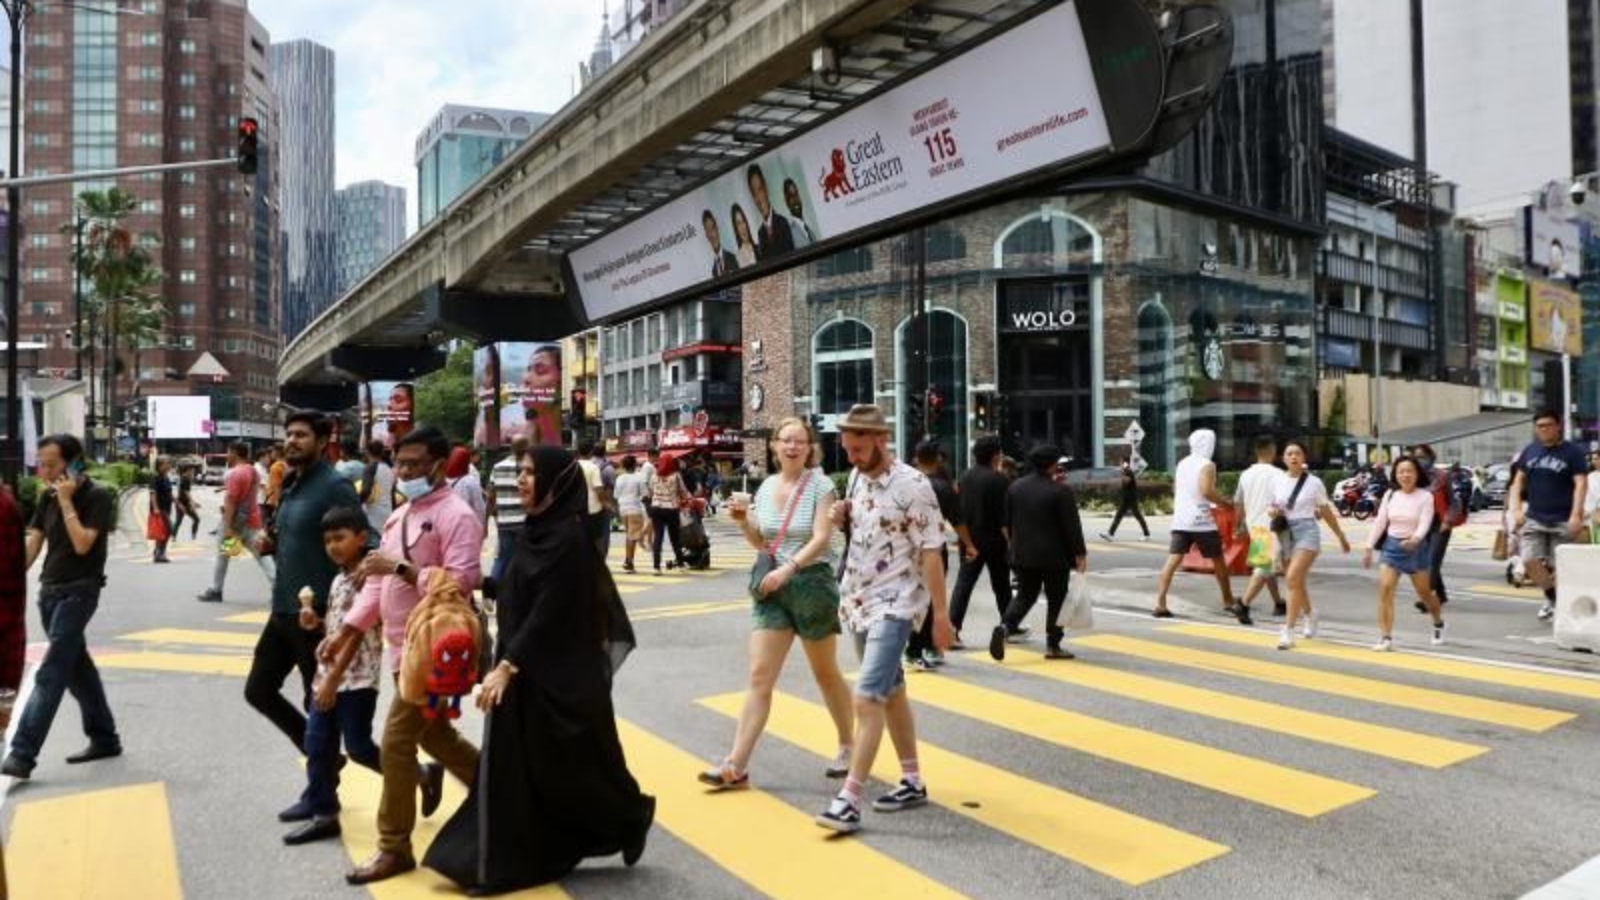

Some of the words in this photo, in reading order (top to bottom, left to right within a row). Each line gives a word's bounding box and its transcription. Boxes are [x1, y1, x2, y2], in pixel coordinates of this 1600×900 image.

[924, 127, 957, 163] 115
[996, 106, 1089, 152] greateasternlife.com
[846, 131, 885, 165] Great
[851, 156, 903, 191] Eastern
[1012, 309, 1075, 328] WOLO
